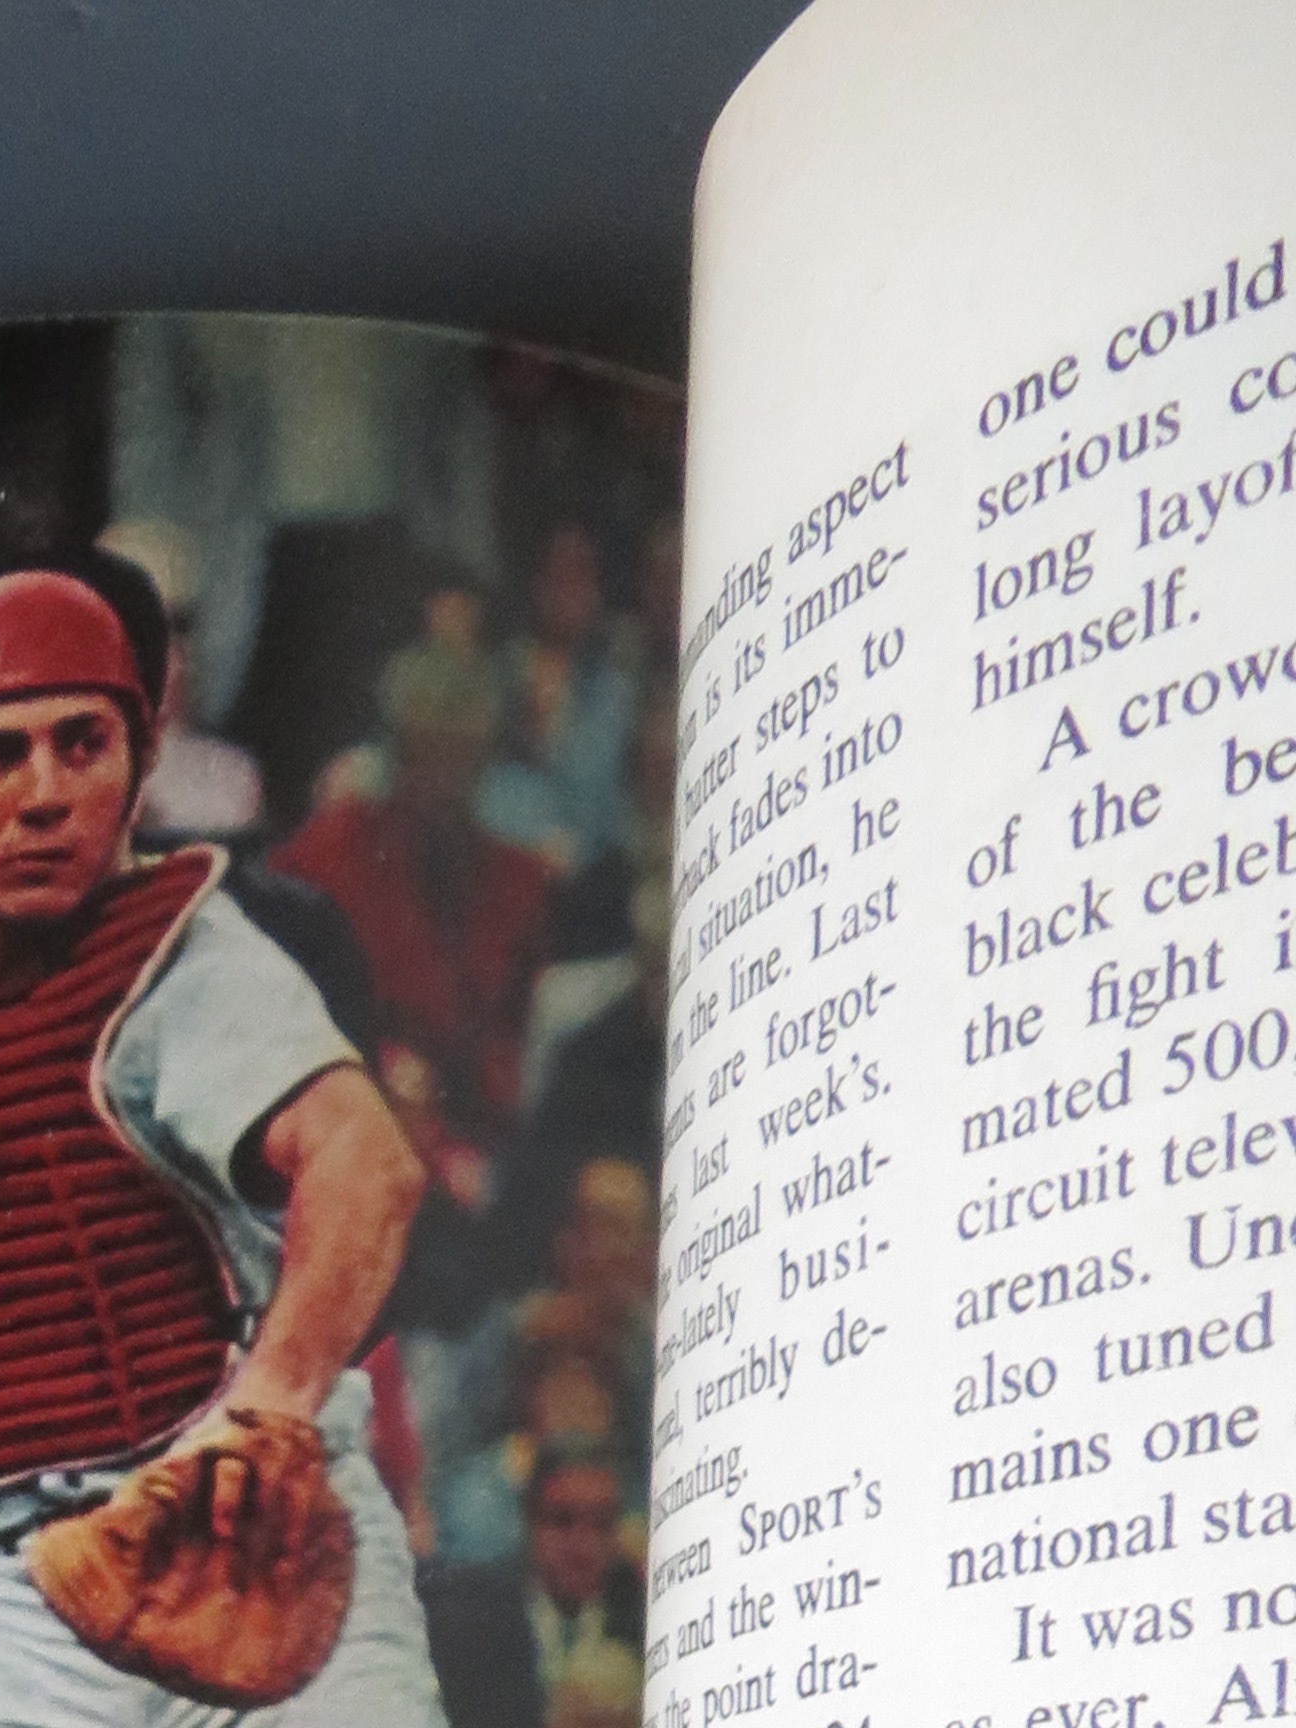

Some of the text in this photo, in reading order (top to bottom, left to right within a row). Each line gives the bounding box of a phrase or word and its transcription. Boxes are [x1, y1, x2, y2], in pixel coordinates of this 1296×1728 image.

[977, 235, 1288, 439] one could
[786, 437, 910, 566] aspect
[975, 398, 1181, 533] serious
[731, 545, 909, 696] its imme-
[972, 527, 1097, 624] long
[754, 659, 840, 755] steps
[860, 624, 905, 681] to
[970, 564, 1201, 714] himself.
[727, 711, 903, 857] fades into
[1036, 703, 1093, 774] A
[697, 796, 901, 964] situation, he
[965, 779, 1162, 890] of the
[727, 874, 899, 1014] line. Last
[963, 875, 1114, 979] black
[764, 970, 897, 1070] forgot-
[963, 937, 1226, 1068] the fight
[961, 1045, 1133, 1156] mated
[676, 1139, 892, 1287] original what-
[955, 1142, 1136, 1242] circuit
[777, 1214, 890, 1302] busi-
[953, 1244, 1151, 1331] arenas.
[694, 1306, 888, 1423] terribly de-
[952, 1288, 1275, 1418] also tuned
[948, 1403, 1260, 1504] mains one
[945, 1489, 1178, 1590] national
[726, 1557, 881, 1641] the win-
[1010, 1596, 1195, 1664] It was
[794, 1642, 878, 1701] dra-
